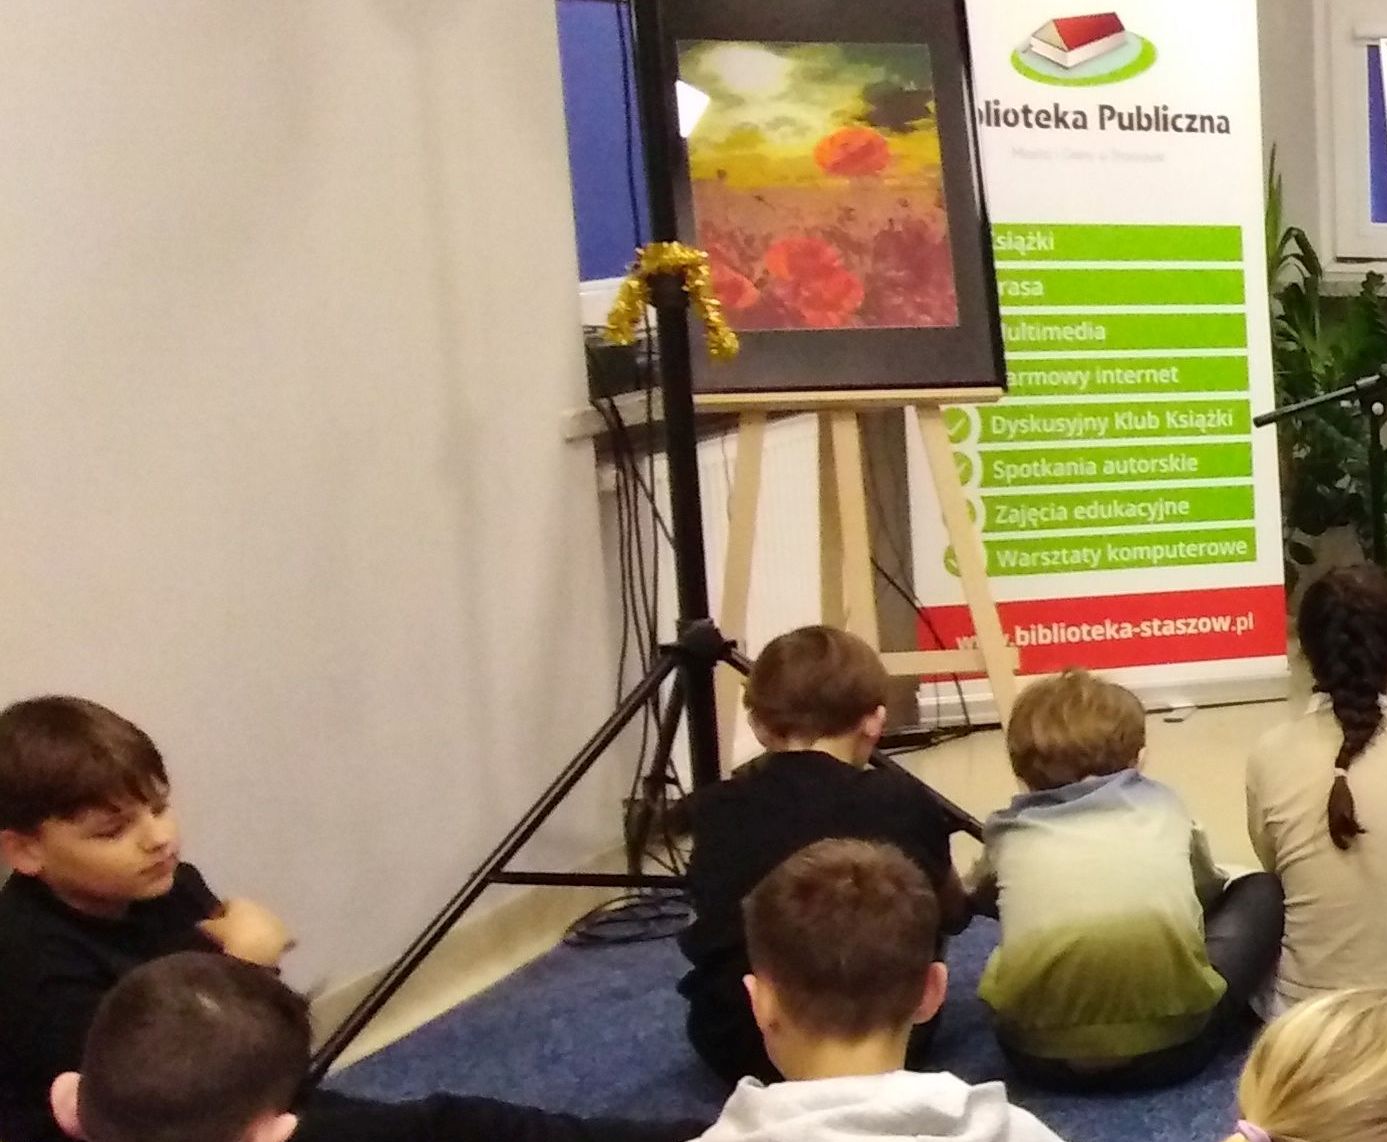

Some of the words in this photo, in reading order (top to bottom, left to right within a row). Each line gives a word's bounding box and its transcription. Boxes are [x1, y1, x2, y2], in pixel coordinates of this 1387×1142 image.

[978, 99, 1088, 131] lioteka
[1098, 104, 1231, 134] Publiczna
[994, 231, 1055, 255] siążki
[998, 280, 1045, 297] rasa
[1001, 322, 1106, 341] ultimedia
[1006, 371, 1090, 390] armowy
[991, 414, 1109, 440] Dyskusyjny
[1115, 411, 1160, 430] Klub
[1166, 409, 1234, 433] Książki
[993, 457, 1097, 483] Spotkania
[1103, 453, 1199, 475] autorskie
[995, 503, 1069, 528] Zajęcia
[1074, 497, 1191, 522] edukacyjne
[996, 547, 1102, 569] Warsztaty
[1107, 538, 1249, 564] komputerowe
[956, 612, 1255, 651] w.biblioteka-staszow.pl
